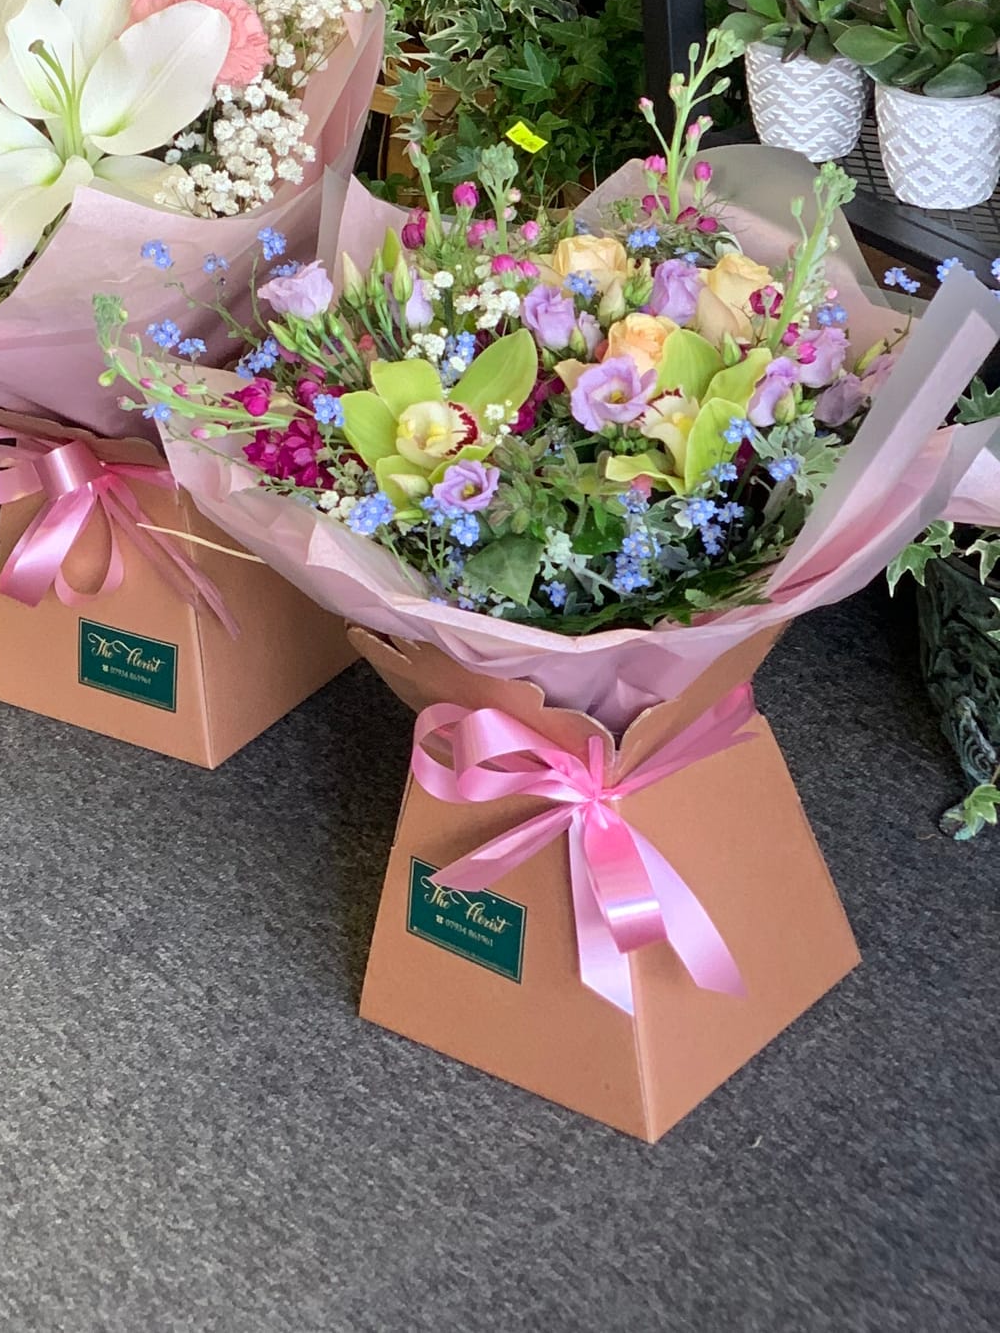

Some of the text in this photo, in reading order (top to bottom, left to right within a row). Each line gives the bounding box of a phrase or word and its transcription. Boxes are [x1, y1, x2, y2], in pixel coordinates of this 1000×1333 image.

[87, 632, 166, 673] The Florist
[420, 875, 513, 934] The Florist
